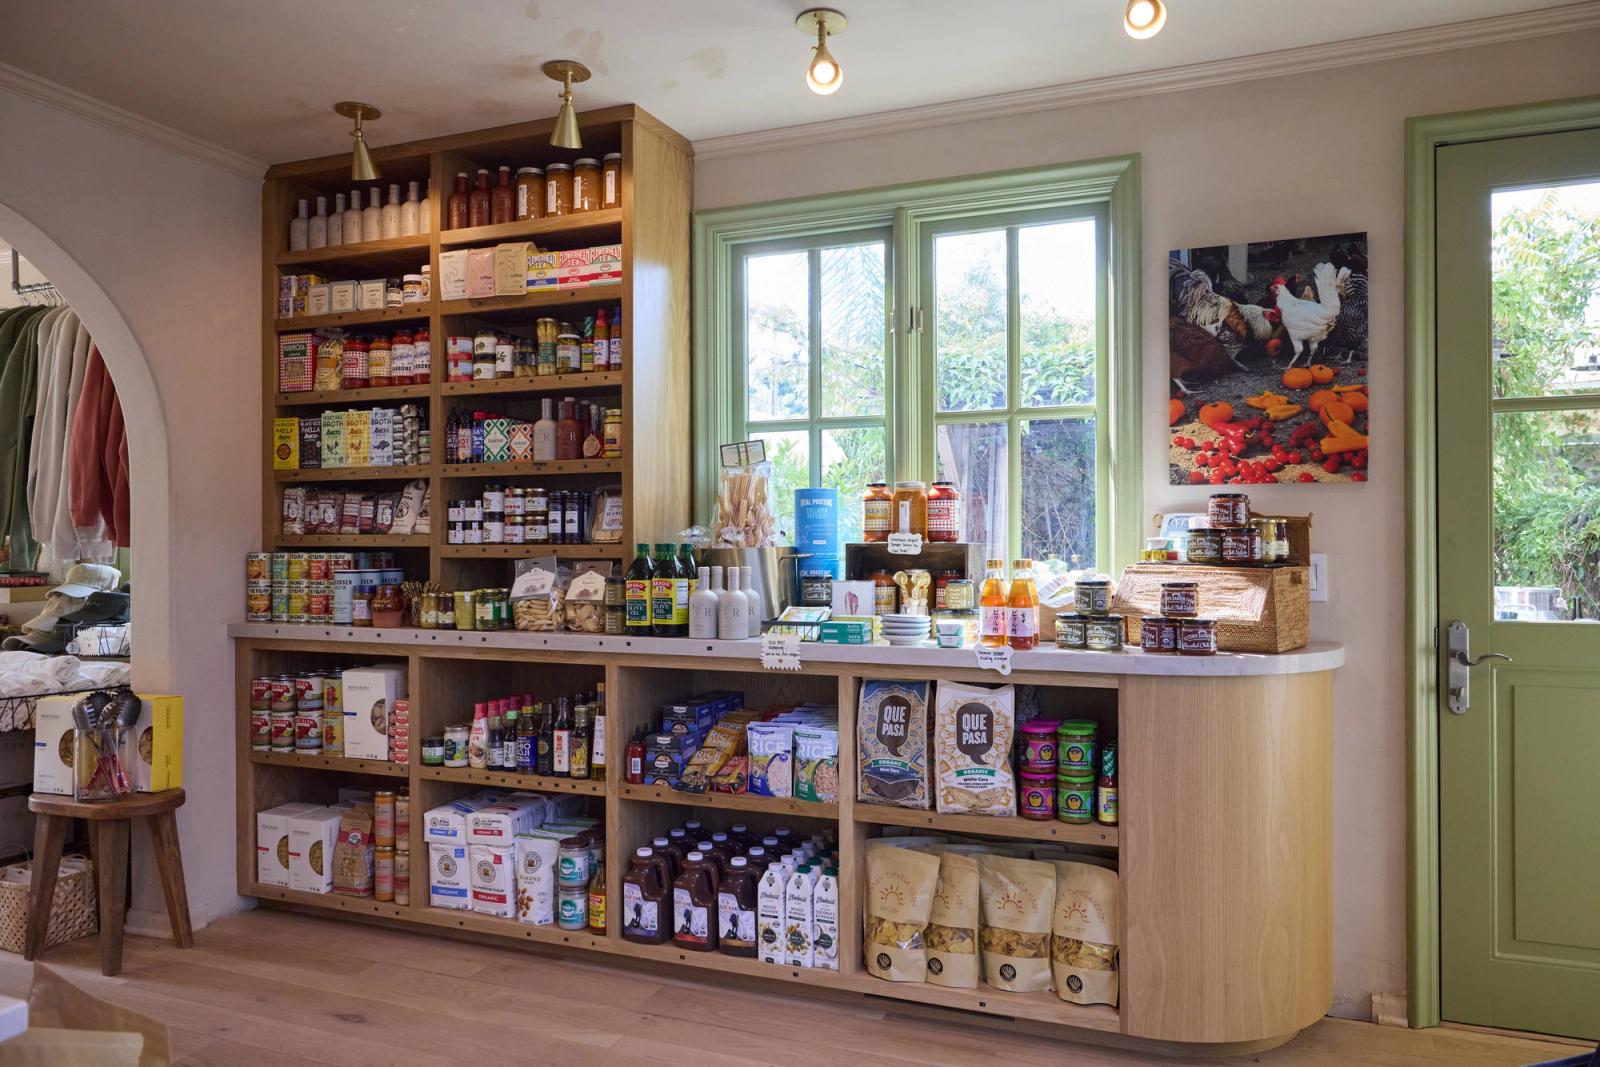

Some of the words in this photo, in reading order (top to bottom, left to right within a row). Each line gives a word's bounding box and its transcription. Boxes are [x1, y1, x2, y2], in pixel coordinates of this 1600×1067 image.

[883, 706, 907, 723] QUE
[962, 713, 987, 731] QUE
[882, 723, 904, 737] PASA
[962, 732, 987, 745] PASA
[751, 741, 785, 753] RICE
[798, 743, 833, 758] RICE
[879, 759, 903, 767] ORGANIC
[520, 874, 541, 882] ALMOND
